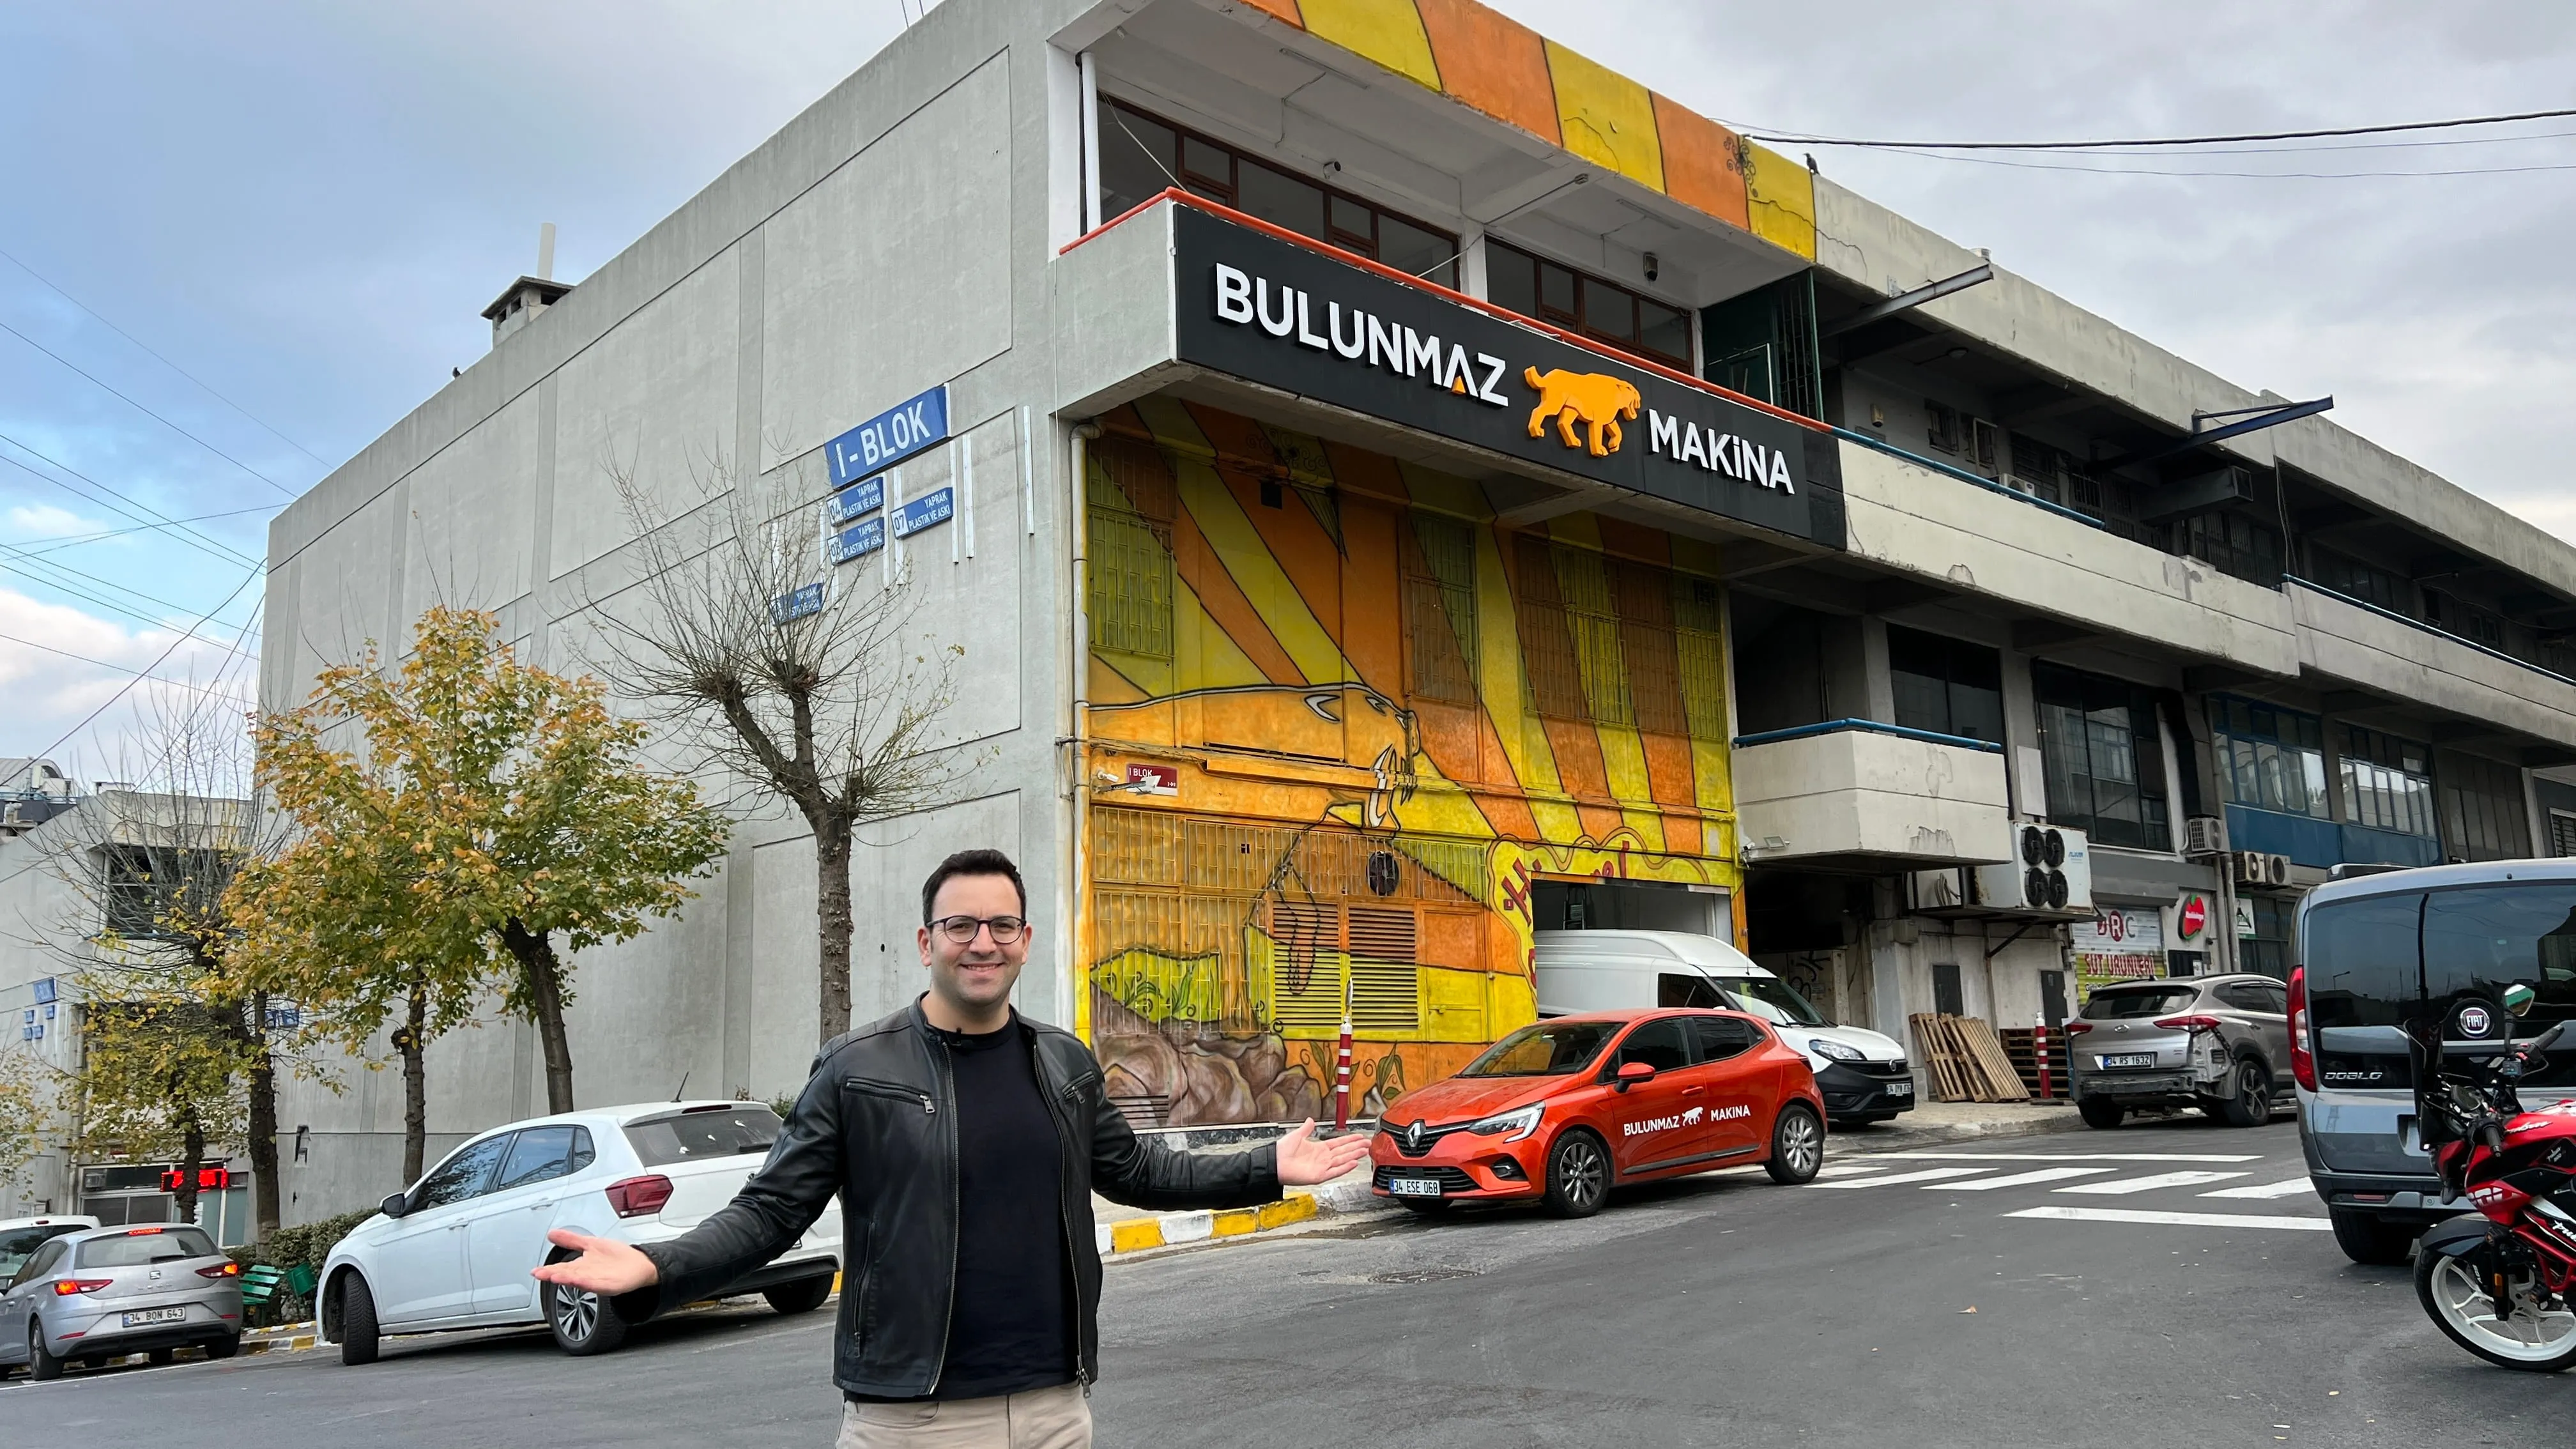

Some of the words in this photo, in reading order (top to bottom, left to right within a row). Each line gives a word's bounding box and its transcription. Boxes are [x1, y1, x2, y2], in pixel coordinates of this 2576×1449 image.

[1216, 263, 1508, 407] BULUNMAZ
[857, 480, 878, 497] YAPRAK
[862, 498, 870, 509] VE
[924, 492, 947, 509] YAPRAK
[894, 514, 904, 530] 07
[929, 510, 937, 521] VE
[857, 521, 879, 537] YAPRAK
[1133, 768, 1153, 778] BLOK
[2465, 1015, 2483, 1028] FIAT
[2120, 1057, 2128, 1065] RS
[2132, 1055, 2149, 1064] 1632
[2324, 1071, 2382, 1080] DOBLO
[1623, 1116, 1680, 1137] BULUNMAZ
[1395, 1180, 1403, 1193] 34
[1406, 1181, 1421, 1193] ESE
[1423, 1181, 1438, 1194] 068
[129, 1313, 141, 1323] 34
[167, 1308, 183, 1319] 643
